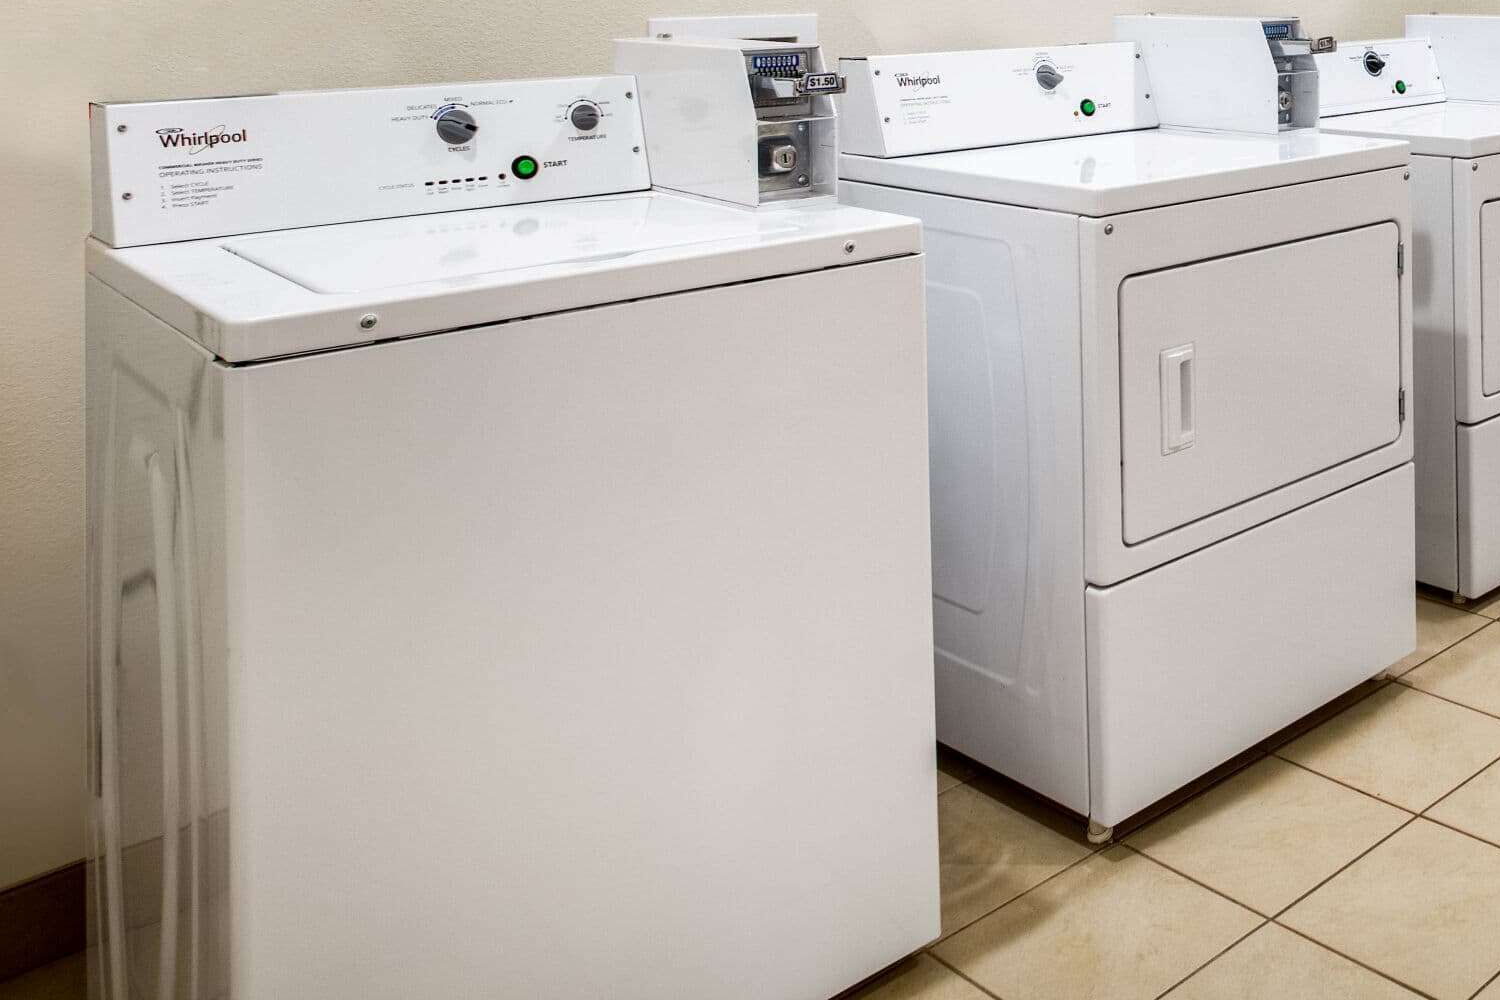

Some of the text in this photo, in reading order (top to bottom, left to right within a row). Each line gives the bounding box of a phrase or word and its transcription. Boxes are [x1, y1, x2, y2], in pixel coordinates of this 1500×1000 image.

[810, 76, 835, 87] $1.50
[896, 75, 940, 88] Whirlpool
[159, 129, 247, 149] Whirlpool
[568, 134, 607, 142] TEMPERATURE
[544, 160, 568, 168] START
[159, 163, 263, 178] OPERATING INSTRUCTIONS
